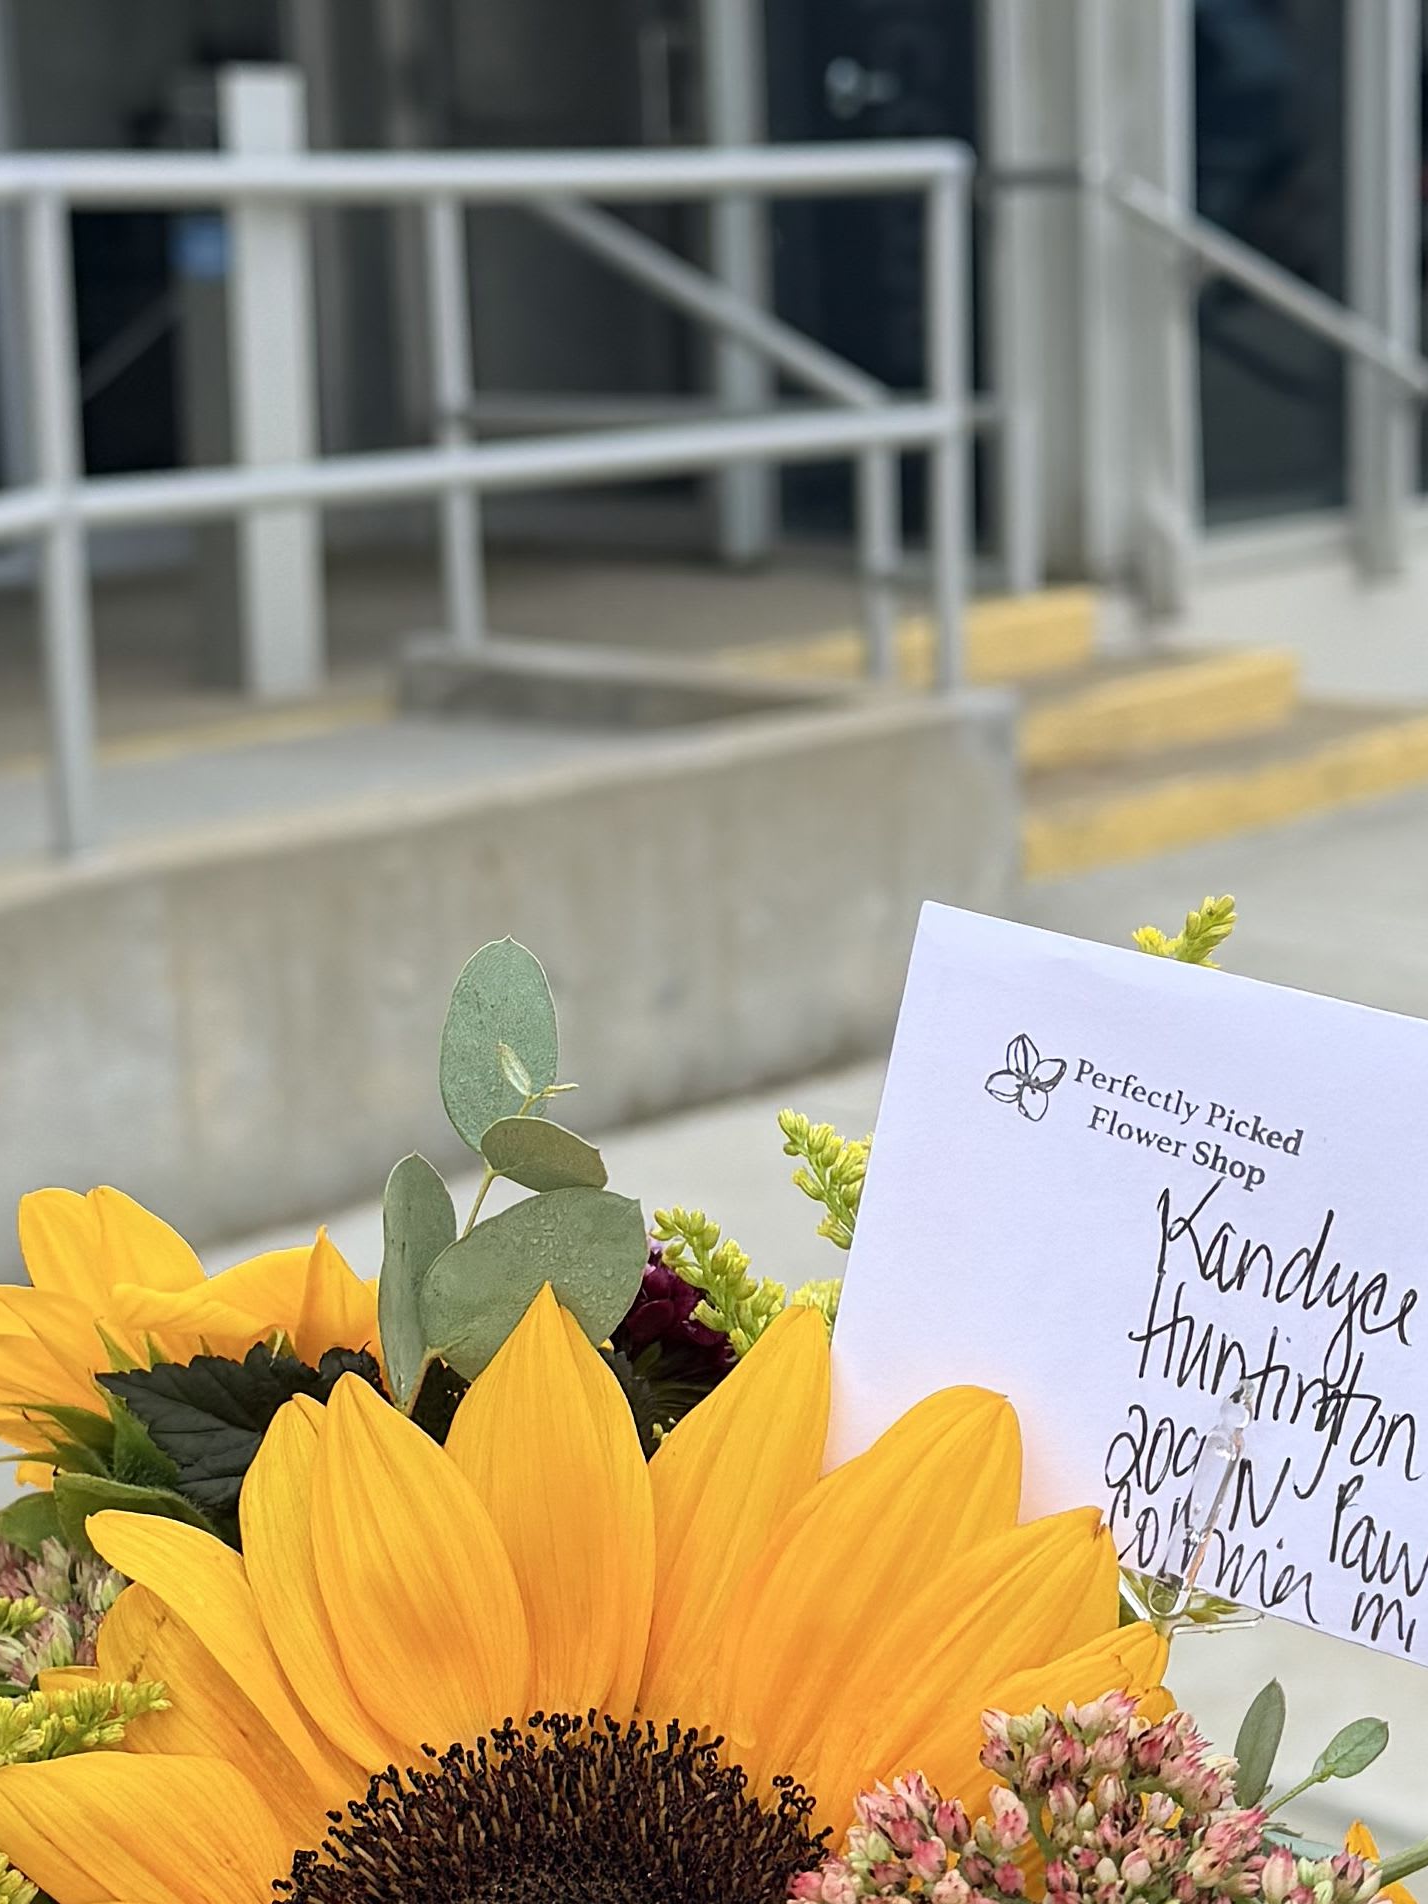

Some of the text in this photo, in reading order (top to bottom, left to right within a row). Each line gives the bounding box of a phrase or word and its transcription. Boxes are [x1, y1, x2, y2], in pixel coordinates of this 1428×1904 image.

[1073, 1057, 1305, 1156] Perfectly Picked
[1087, 1104, 1267, 1193] Flower Shop
[1157, 1177, 1419, 1387] Kandyce
